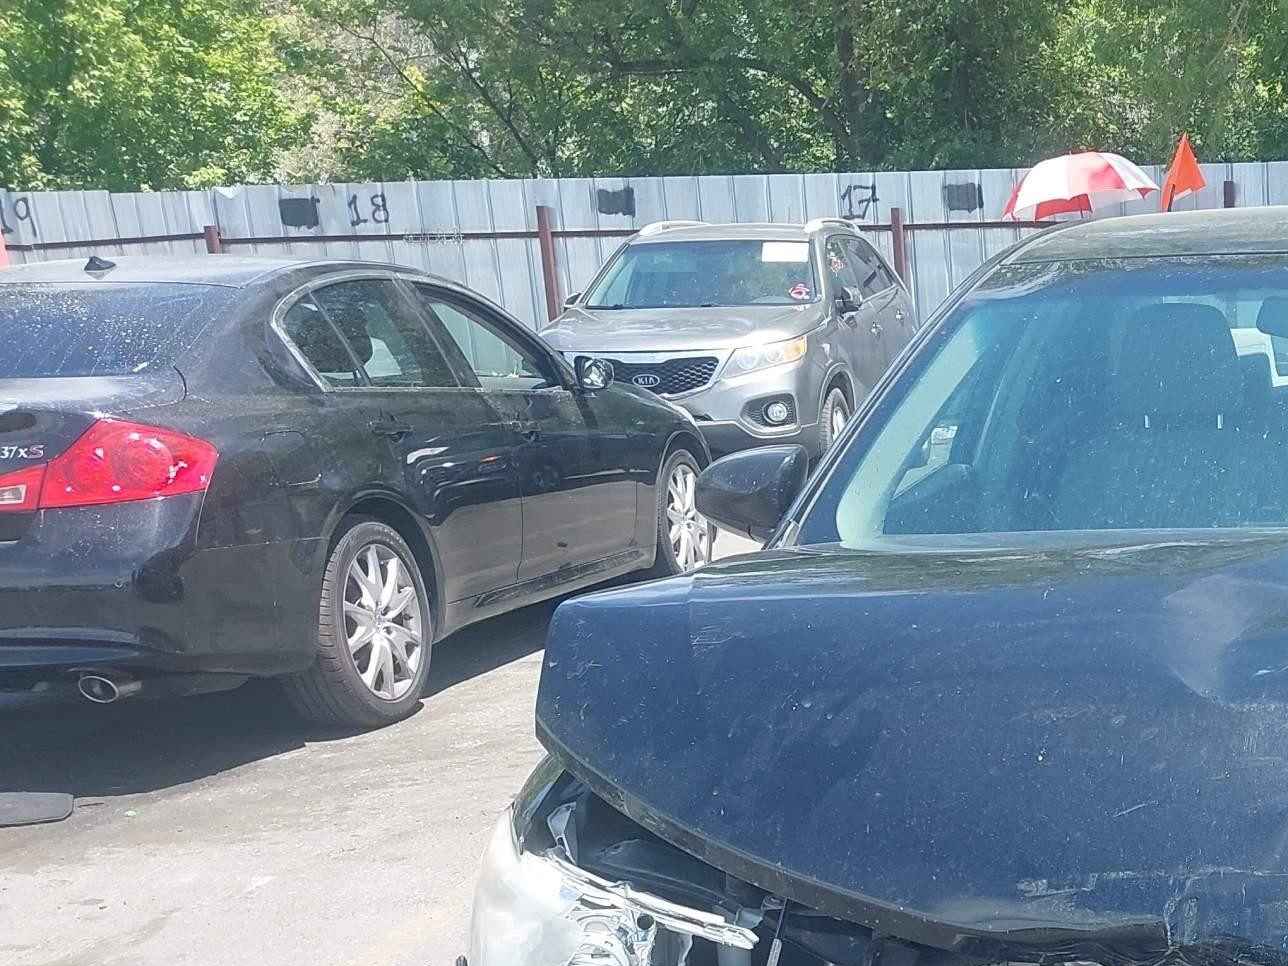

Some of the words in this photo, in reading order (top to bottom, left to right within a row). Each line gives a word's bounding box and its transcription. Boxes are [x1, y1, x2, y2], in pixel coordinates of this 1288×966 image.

[348, 194, 390, 226] 18
[840, 184, 880, 220] 17
[638, 376, 656, 384] KIA
